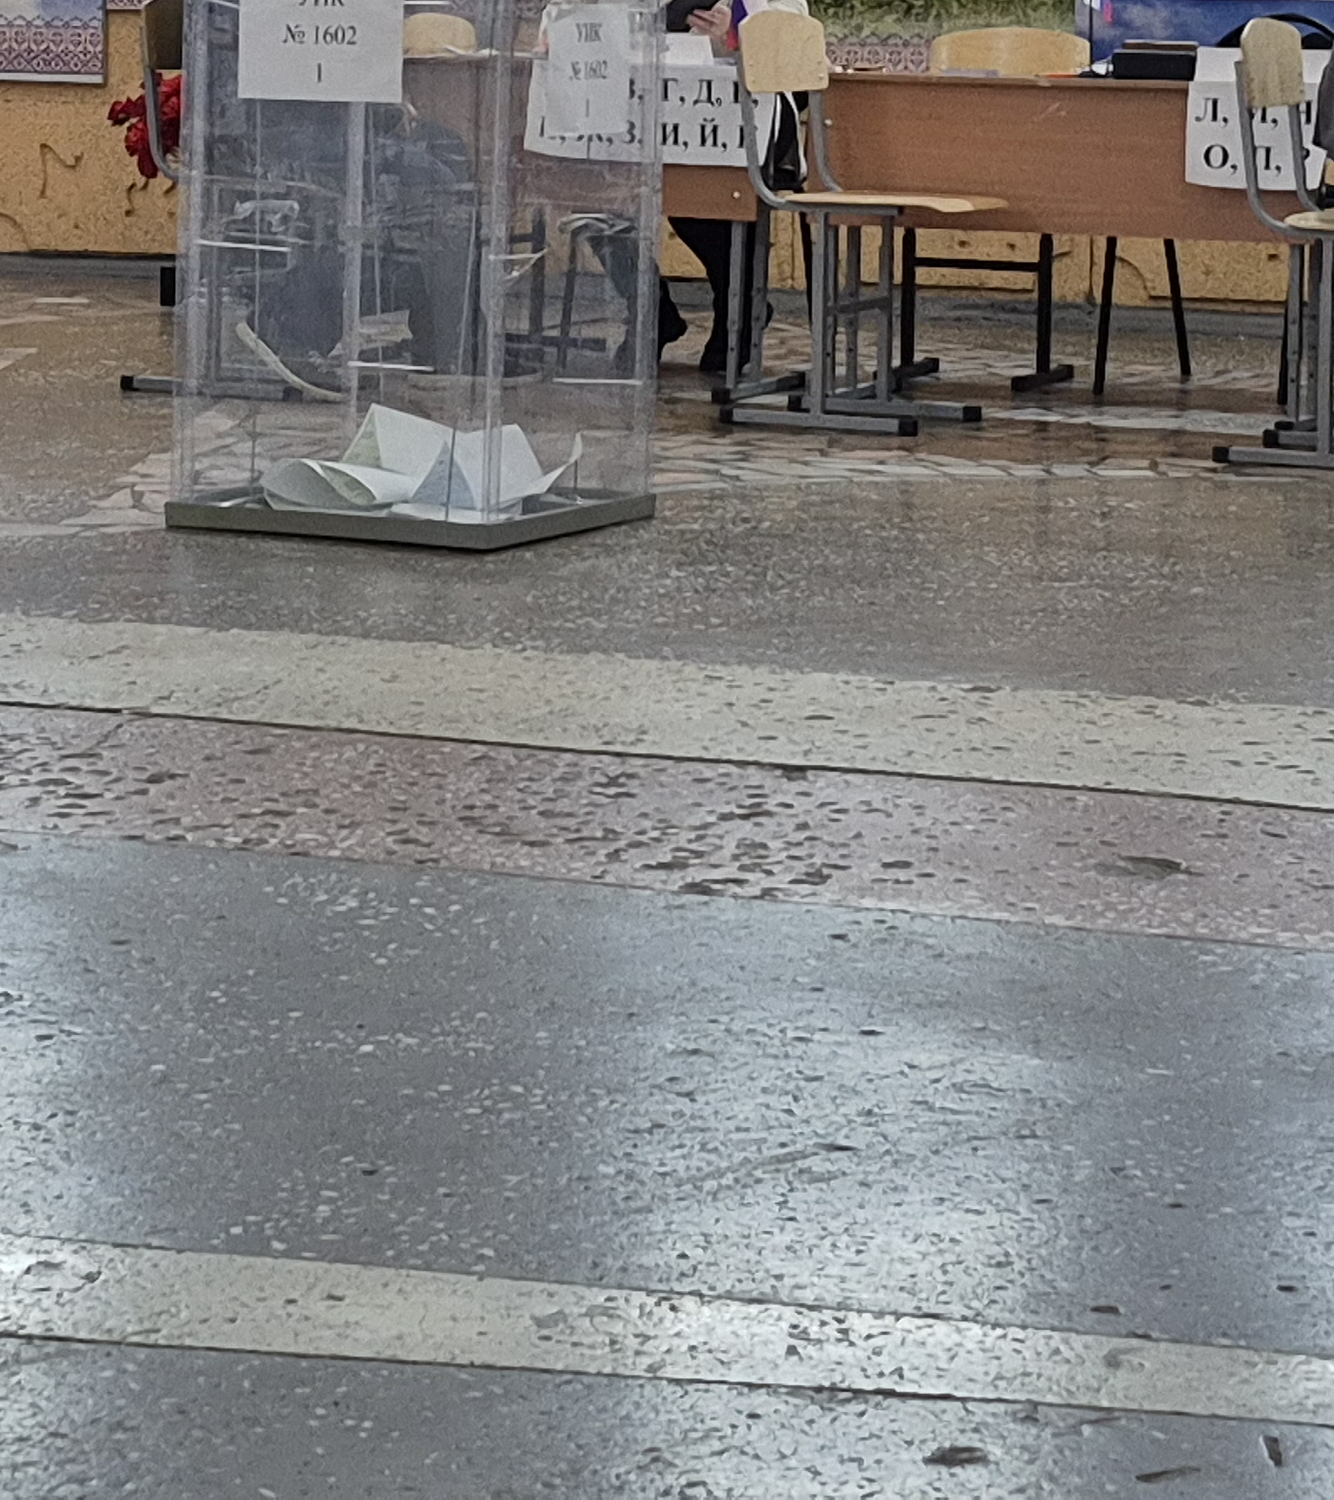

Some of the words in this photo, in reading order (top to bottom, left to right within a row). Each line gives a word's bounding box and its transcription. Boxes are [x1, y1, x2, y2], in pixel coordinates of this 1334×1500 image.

[282, 24, 306, 44] №
[314, 24, 358, 45] 1602
[662, 78, 686, 105] Г,
[693, 78, 723, 107] Д,
[1194, 98, 1229, 128] Л,
[661, 122, 689, 151] И,
[699, 117, 728, 152] Й,
[1203, 144, 1238, 177] О,
